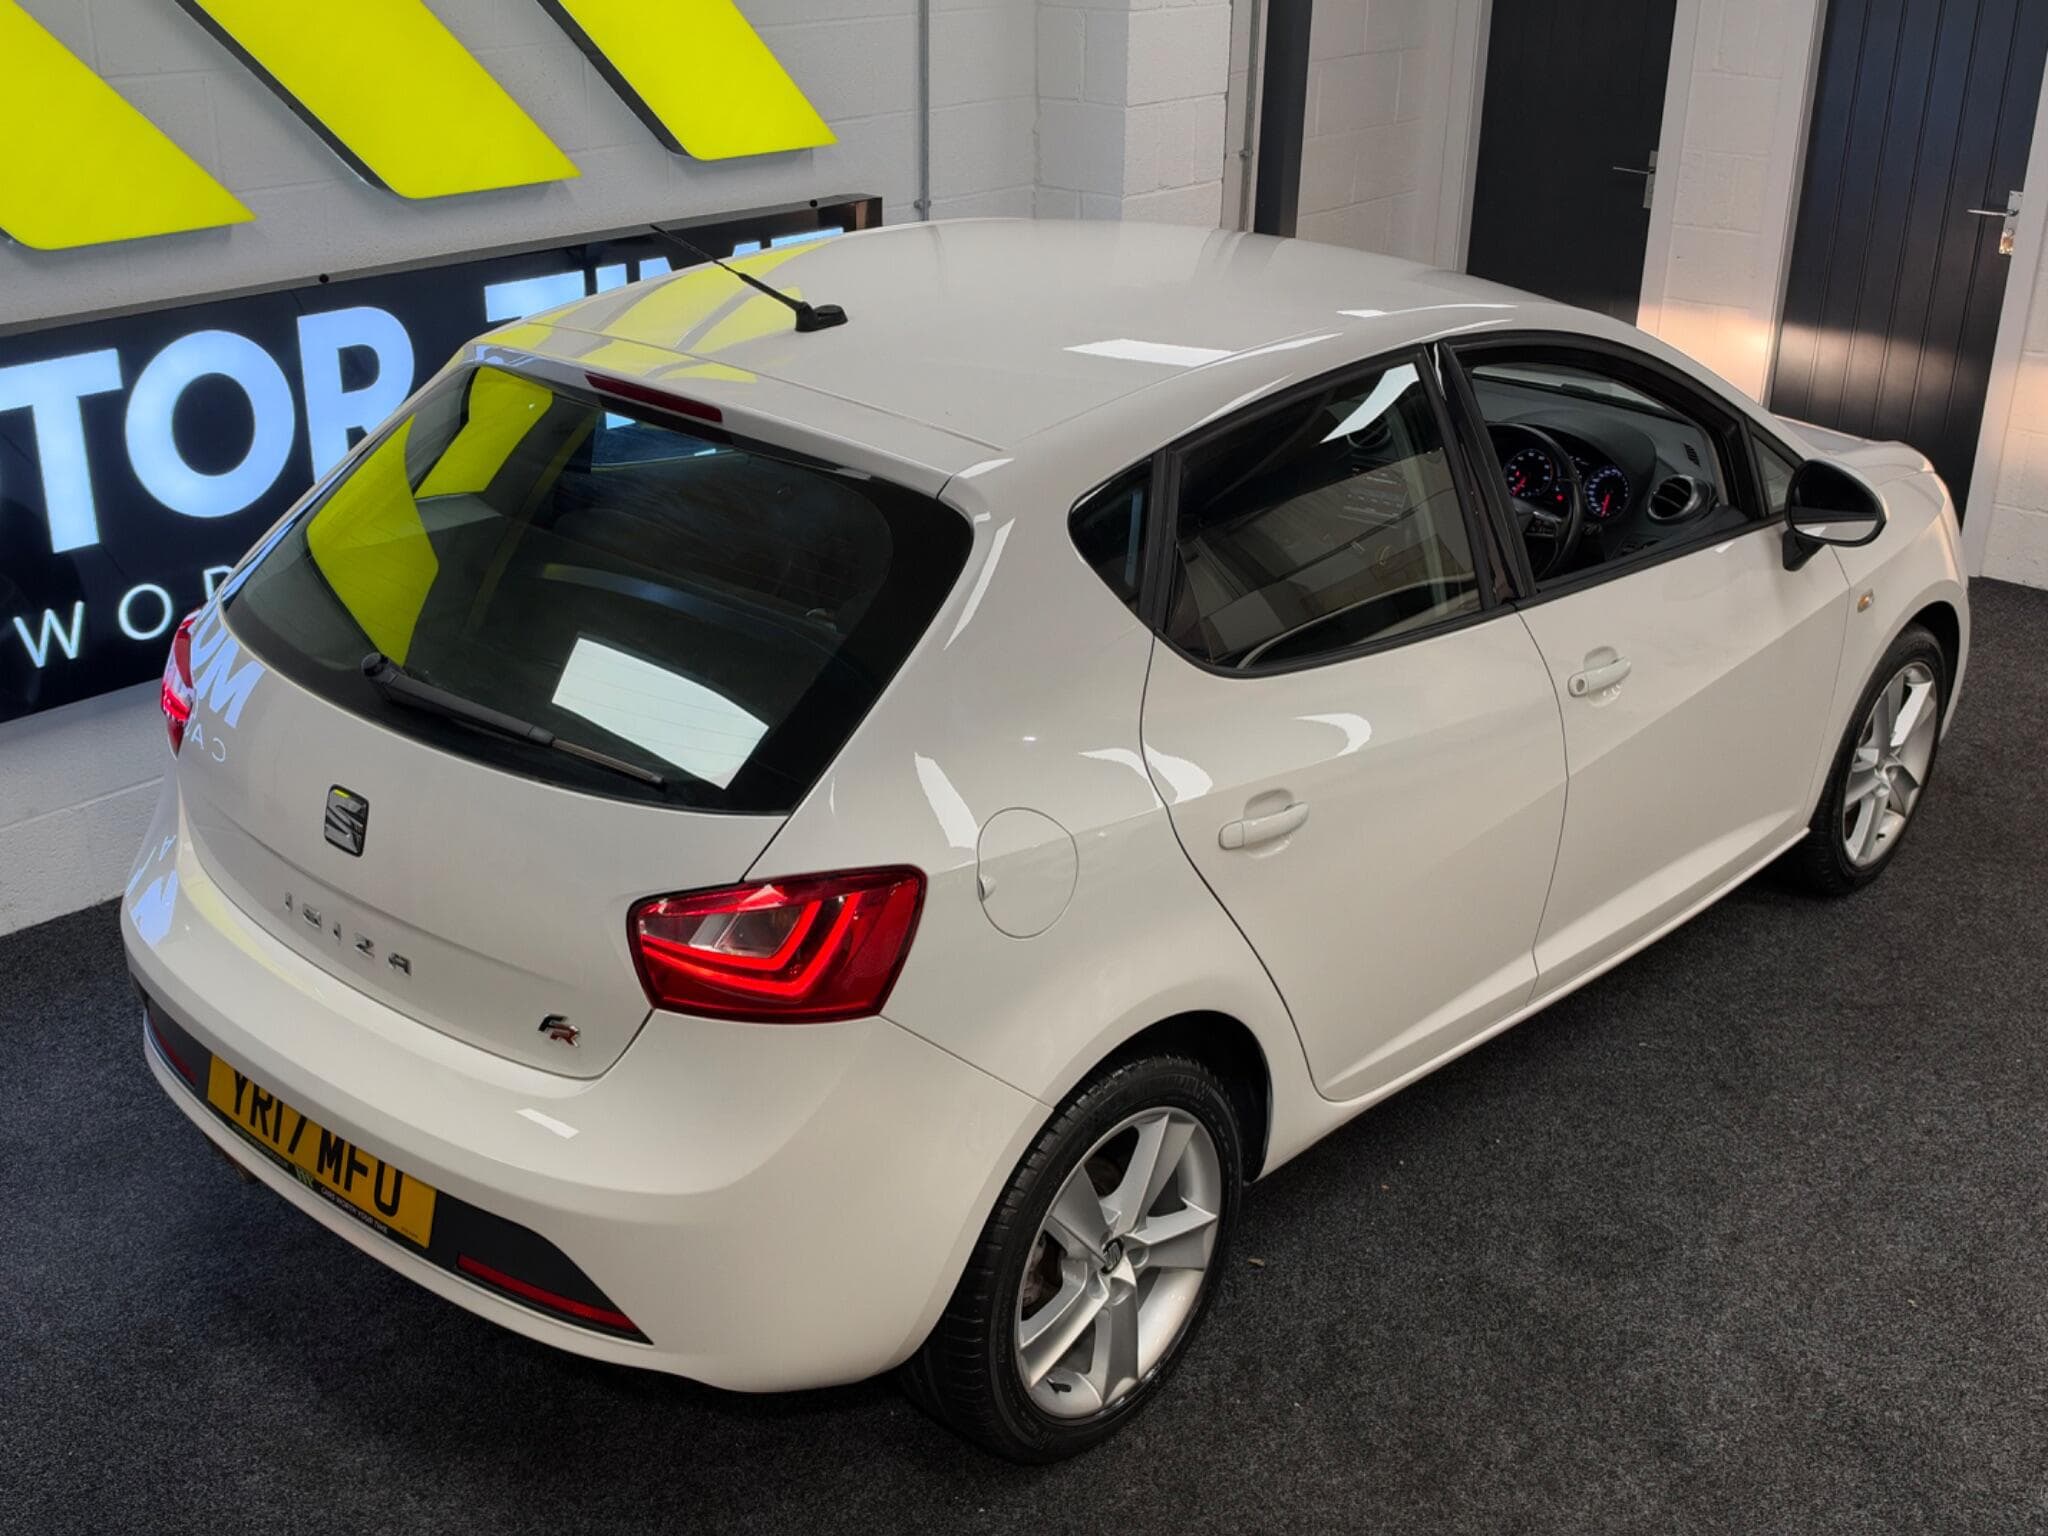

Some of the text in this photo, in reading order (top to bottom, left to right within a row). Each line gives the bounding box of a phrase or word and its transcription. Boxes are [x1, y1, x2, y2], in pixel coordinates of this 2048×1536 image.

[284, 891, 411, 977] IBIZA
[538, 1013, 580, 1047] FR
[316, 1128, 405, 1218] MFU
